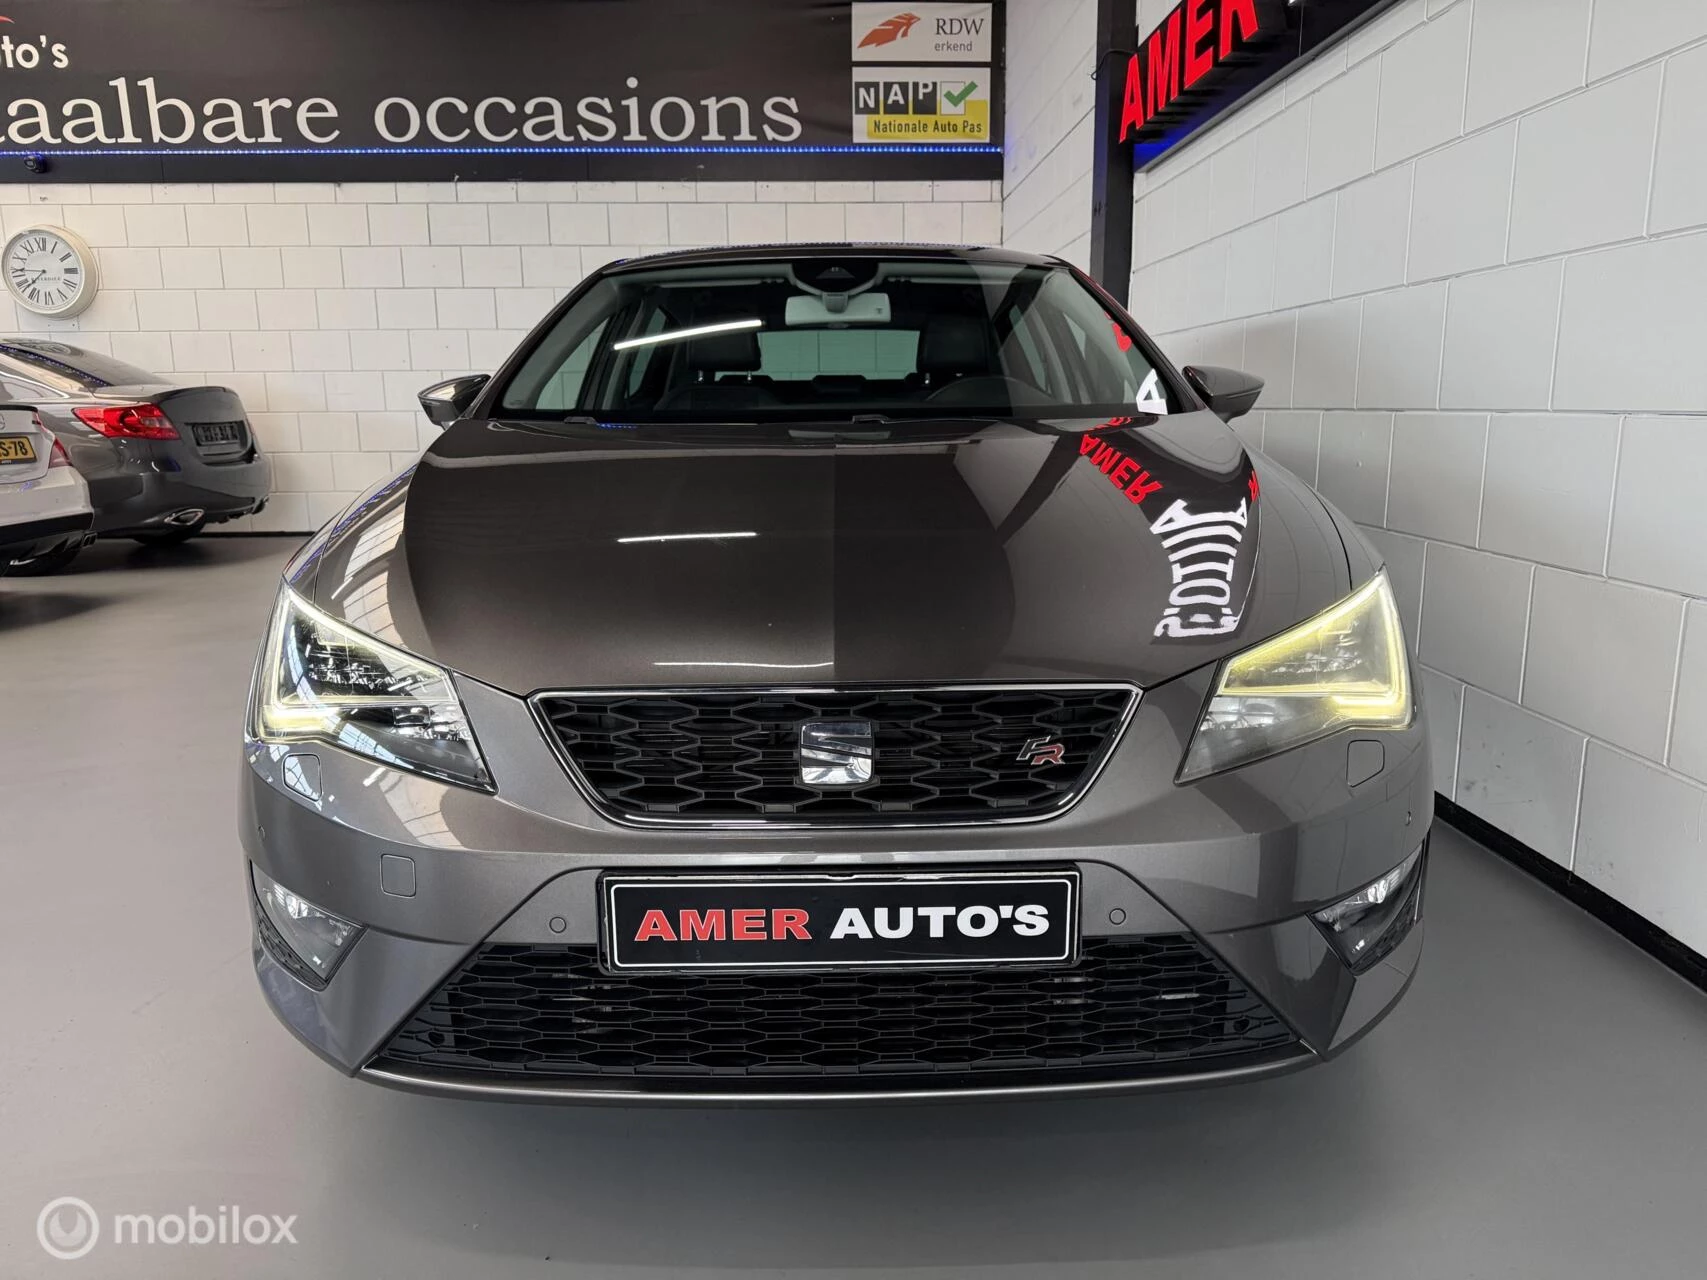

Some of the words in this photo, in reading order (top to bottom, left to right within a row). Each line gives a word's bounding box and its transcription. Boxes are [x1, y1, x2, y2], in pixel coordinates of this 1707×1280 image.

[935, 18, 984, 36] RDW
[0, 34, 69, 69] to's
[934, 41, 973, 52] erkend
[0, 77, 340, 144] aalbare
[374, 76, 802, 143] occasions
[858, 83, 933, 109] NAP
[873, 120, 928, 133] Nationale
[933, 120, 958, 133] Auto
[962, 120, 982, 133] Pas
[1016, 735, 1066, 766] FR
[634, 908, 812, 942] AMER
[829, 904, 1050, 939] AUTO'S
